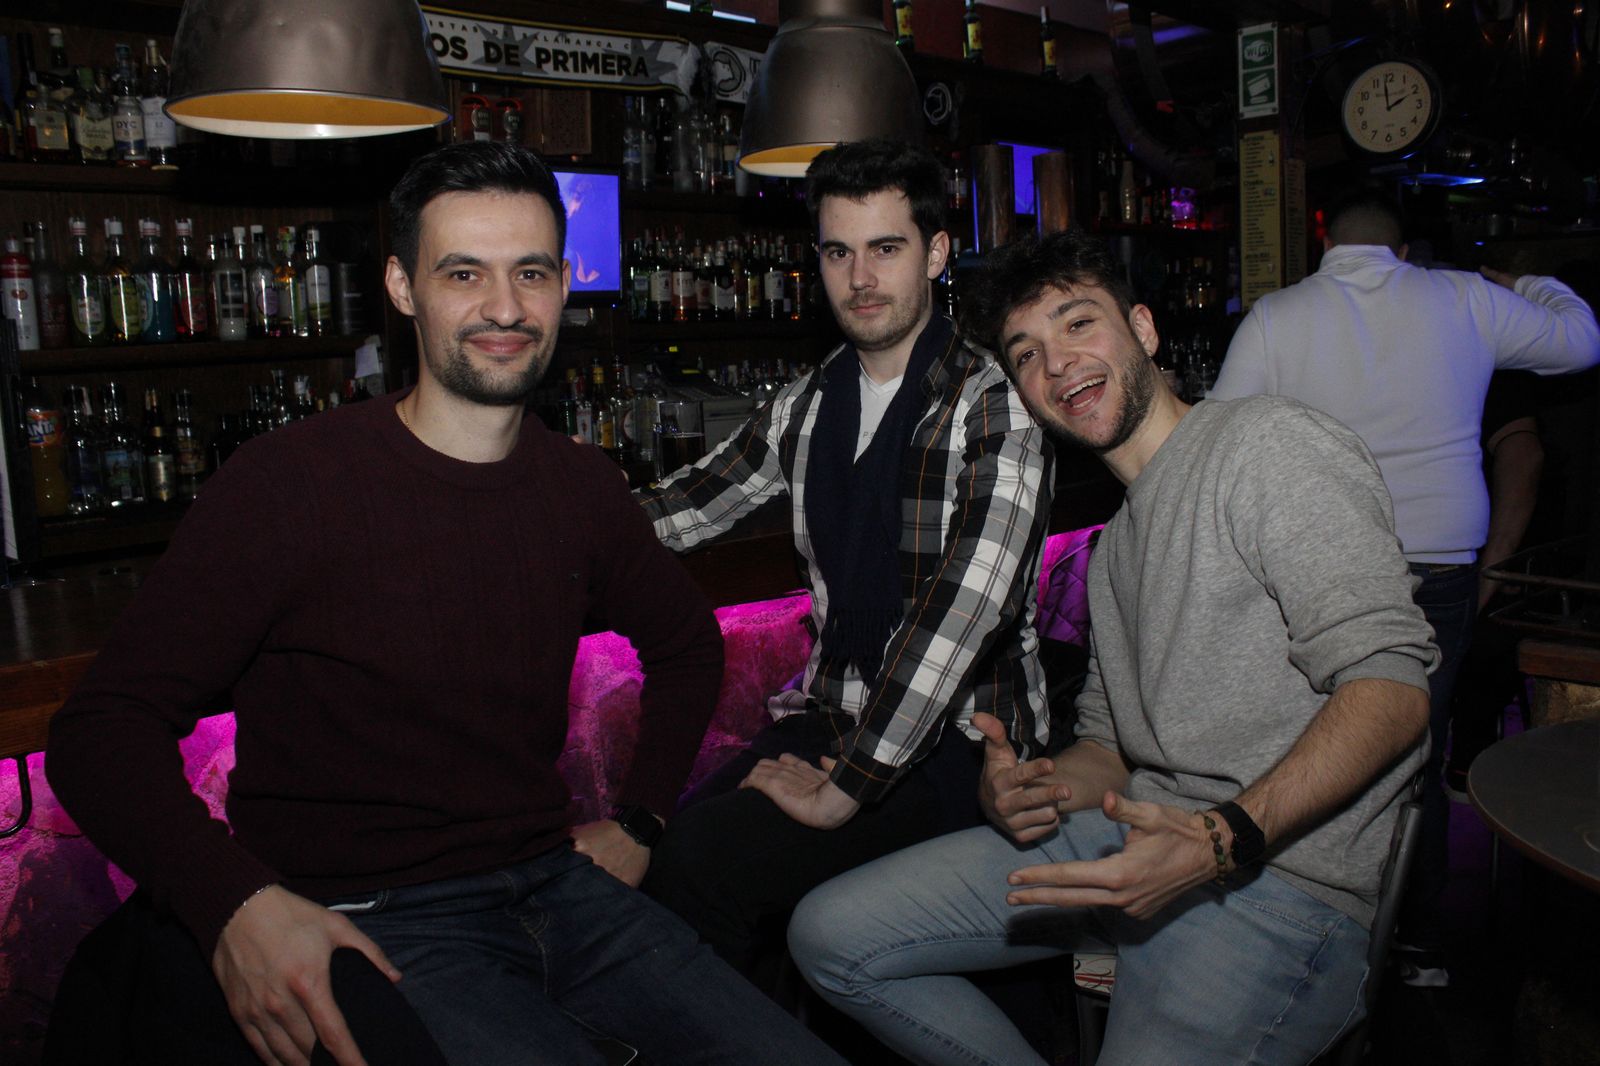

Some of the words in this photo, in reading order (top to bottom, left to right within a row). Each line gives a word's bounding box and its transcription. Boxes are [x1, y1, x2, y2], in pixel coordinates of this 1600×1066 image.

[483, 40, 520, 66] DE
[1411, 84, 1419, 95] 2
[1361, 91, 1369, 101] 10
[1415, 99, 1422, 109] 3
[1357, 107, 1364, 116] 9
[116, 120, 137, 128] DYC
[1361, 120, 1367, 130] 8
[1411, 115, 1418, 126] 4
[1371, 130, 1378, 140] 7
[1400, 127, 1407, 138] 5
[1385, 133, 1392, 143] 6
